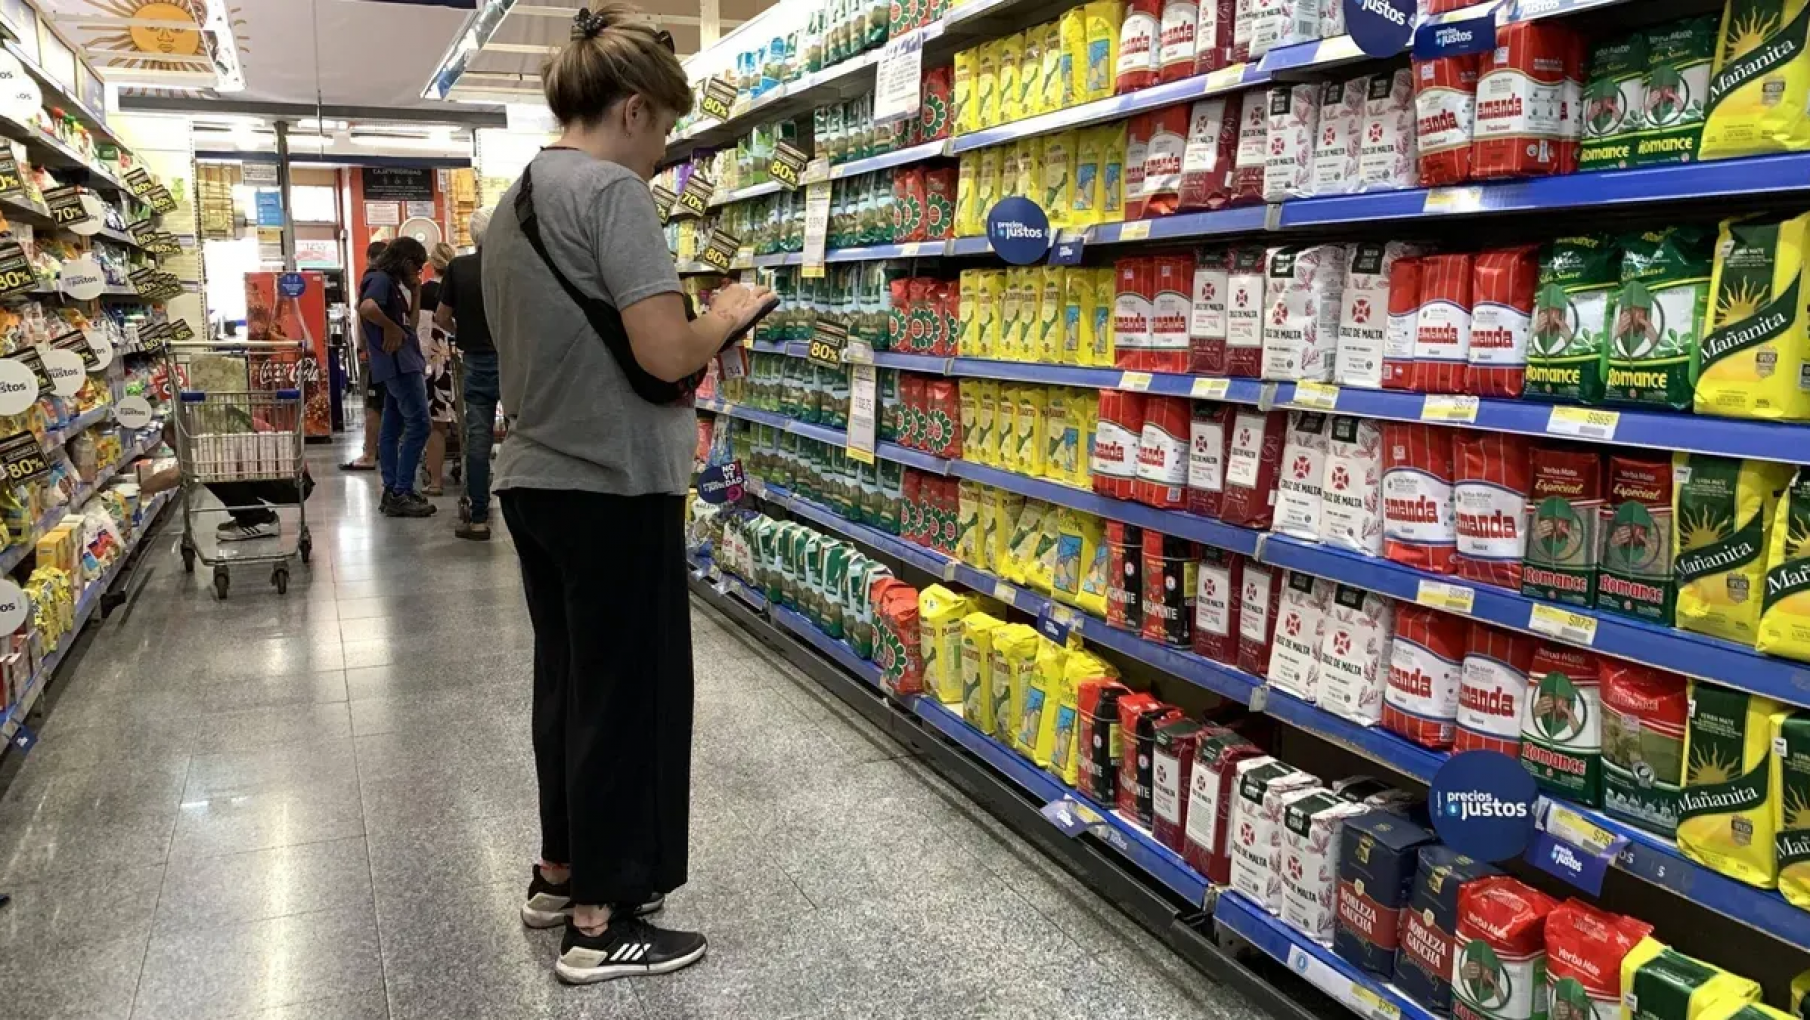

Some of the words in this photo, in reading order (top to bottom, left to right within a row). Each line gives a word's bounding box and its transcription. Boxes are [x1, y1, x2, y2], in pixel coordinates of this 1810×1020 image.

[1441, 29, 1473, 47] justos
[1709, 38, 1795, 102] Mañanita
[703, 97, 727, 116] 80%
[1477, 93, 1523, 121] amanda
[771, 161, 798, 184] 80%
[0, 176, 19, 191] 0%
[681, 191, 703, 211] 70%
[53, 205, 83, 224] 70%
[997, 222, 1024, 230] precios
[1006, 226, 1042, 240] justos
[705, 247, 729, 267] 80%
[1281, 330, 1301, 339] MALTA
[1362, 330, 1383, 340] MALTA
[1701, 312, 1786, 363] Mañanita
[810, 341, 840, 362] 80%
[1526, 364, 1580, 383] Romance
[1608, 368, 1667, 388] Romance
[8, 457, 44, 478] 80%
[1293, 481, 1301, 491] DE
[1301, 484, 1322, 496] MALTA
[1535, 479, 1583, 494] Especial
[1613, 484, 1660, 500] Especial
[1334, 493, 1342, 504] DE
[1342, 496, 1362, 508] MALTA
[1384, 495, 1439, 523] amanda
[1676, 541, 1753, 579] Mañanita
[1523, 567, 1587, 593] Romance
[1599, 574, 1663, 605] Romance
[1292, 640, 1310, 656] MALTA
[1341, 661, 1361, 676] MALTA
[1523, 742, 1587, 776] Romance
[1447, 789, 1492, 802] precios
[1678, 784, 1759, 815] Mañanita
[1461, 798, 1527, 821] justos
[1249, 850, 1267, 868] MALTA
[1556, 851, 1583, 872] justos
[1297, 885, 1317, 902] MALTA
[1341, 887, 1377, 923] NOBLEZA
[1340, 902, 1373, 934] GAUCHA
[1468, 911, 1488, 929] Yerba
[1408, 916, 1446, 956] NOBLEZA
[1406, 931, 1441, 969] GAUCHA
[1558, 946, 1583, 967] Yerba
[1583, 959, 1601, 976] Mate
